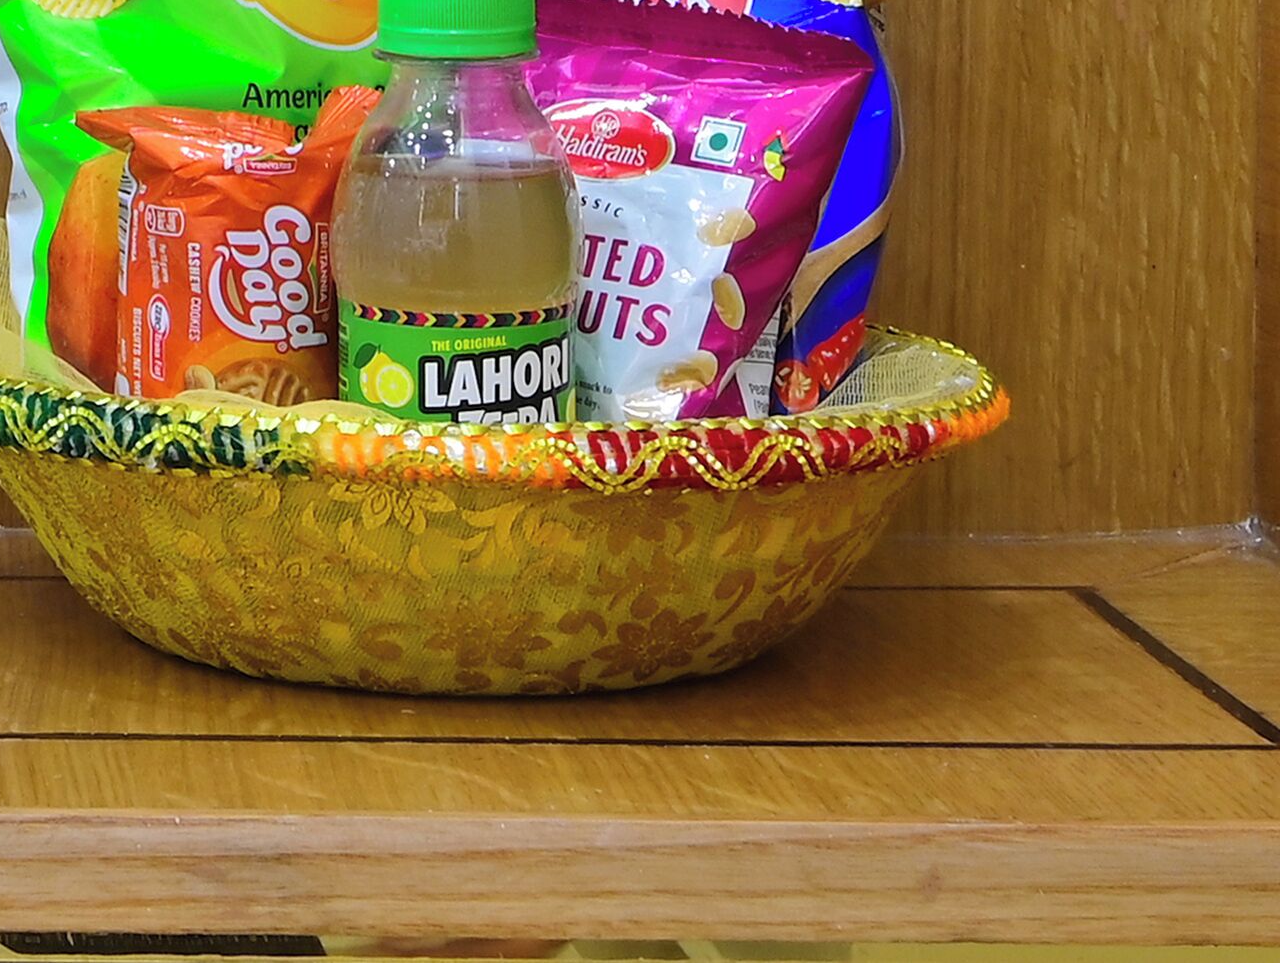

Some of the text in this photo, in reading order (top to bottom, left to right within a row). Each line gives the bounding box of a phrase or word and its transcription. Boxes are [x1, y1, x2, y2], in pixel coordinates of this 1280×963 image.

[556, 124, 648, 167] Haldiram's
[580, 196, 624, 218] SSIC
[209, 230, 288, 341] Day
[264, 205, 328, 349] Good
[319, 232, 329, 304] BRITANNIA
[583, 234, 665, 287] TED
[153, 304, 162, 331] ZERO
[188, 242, 202, 343] CASHEW COOKIES
[577, 290, 671, 347] UTS
[432, 336, 507, 352] THE ORIGINAL
[424, 338, 568, 408] LAHORI
